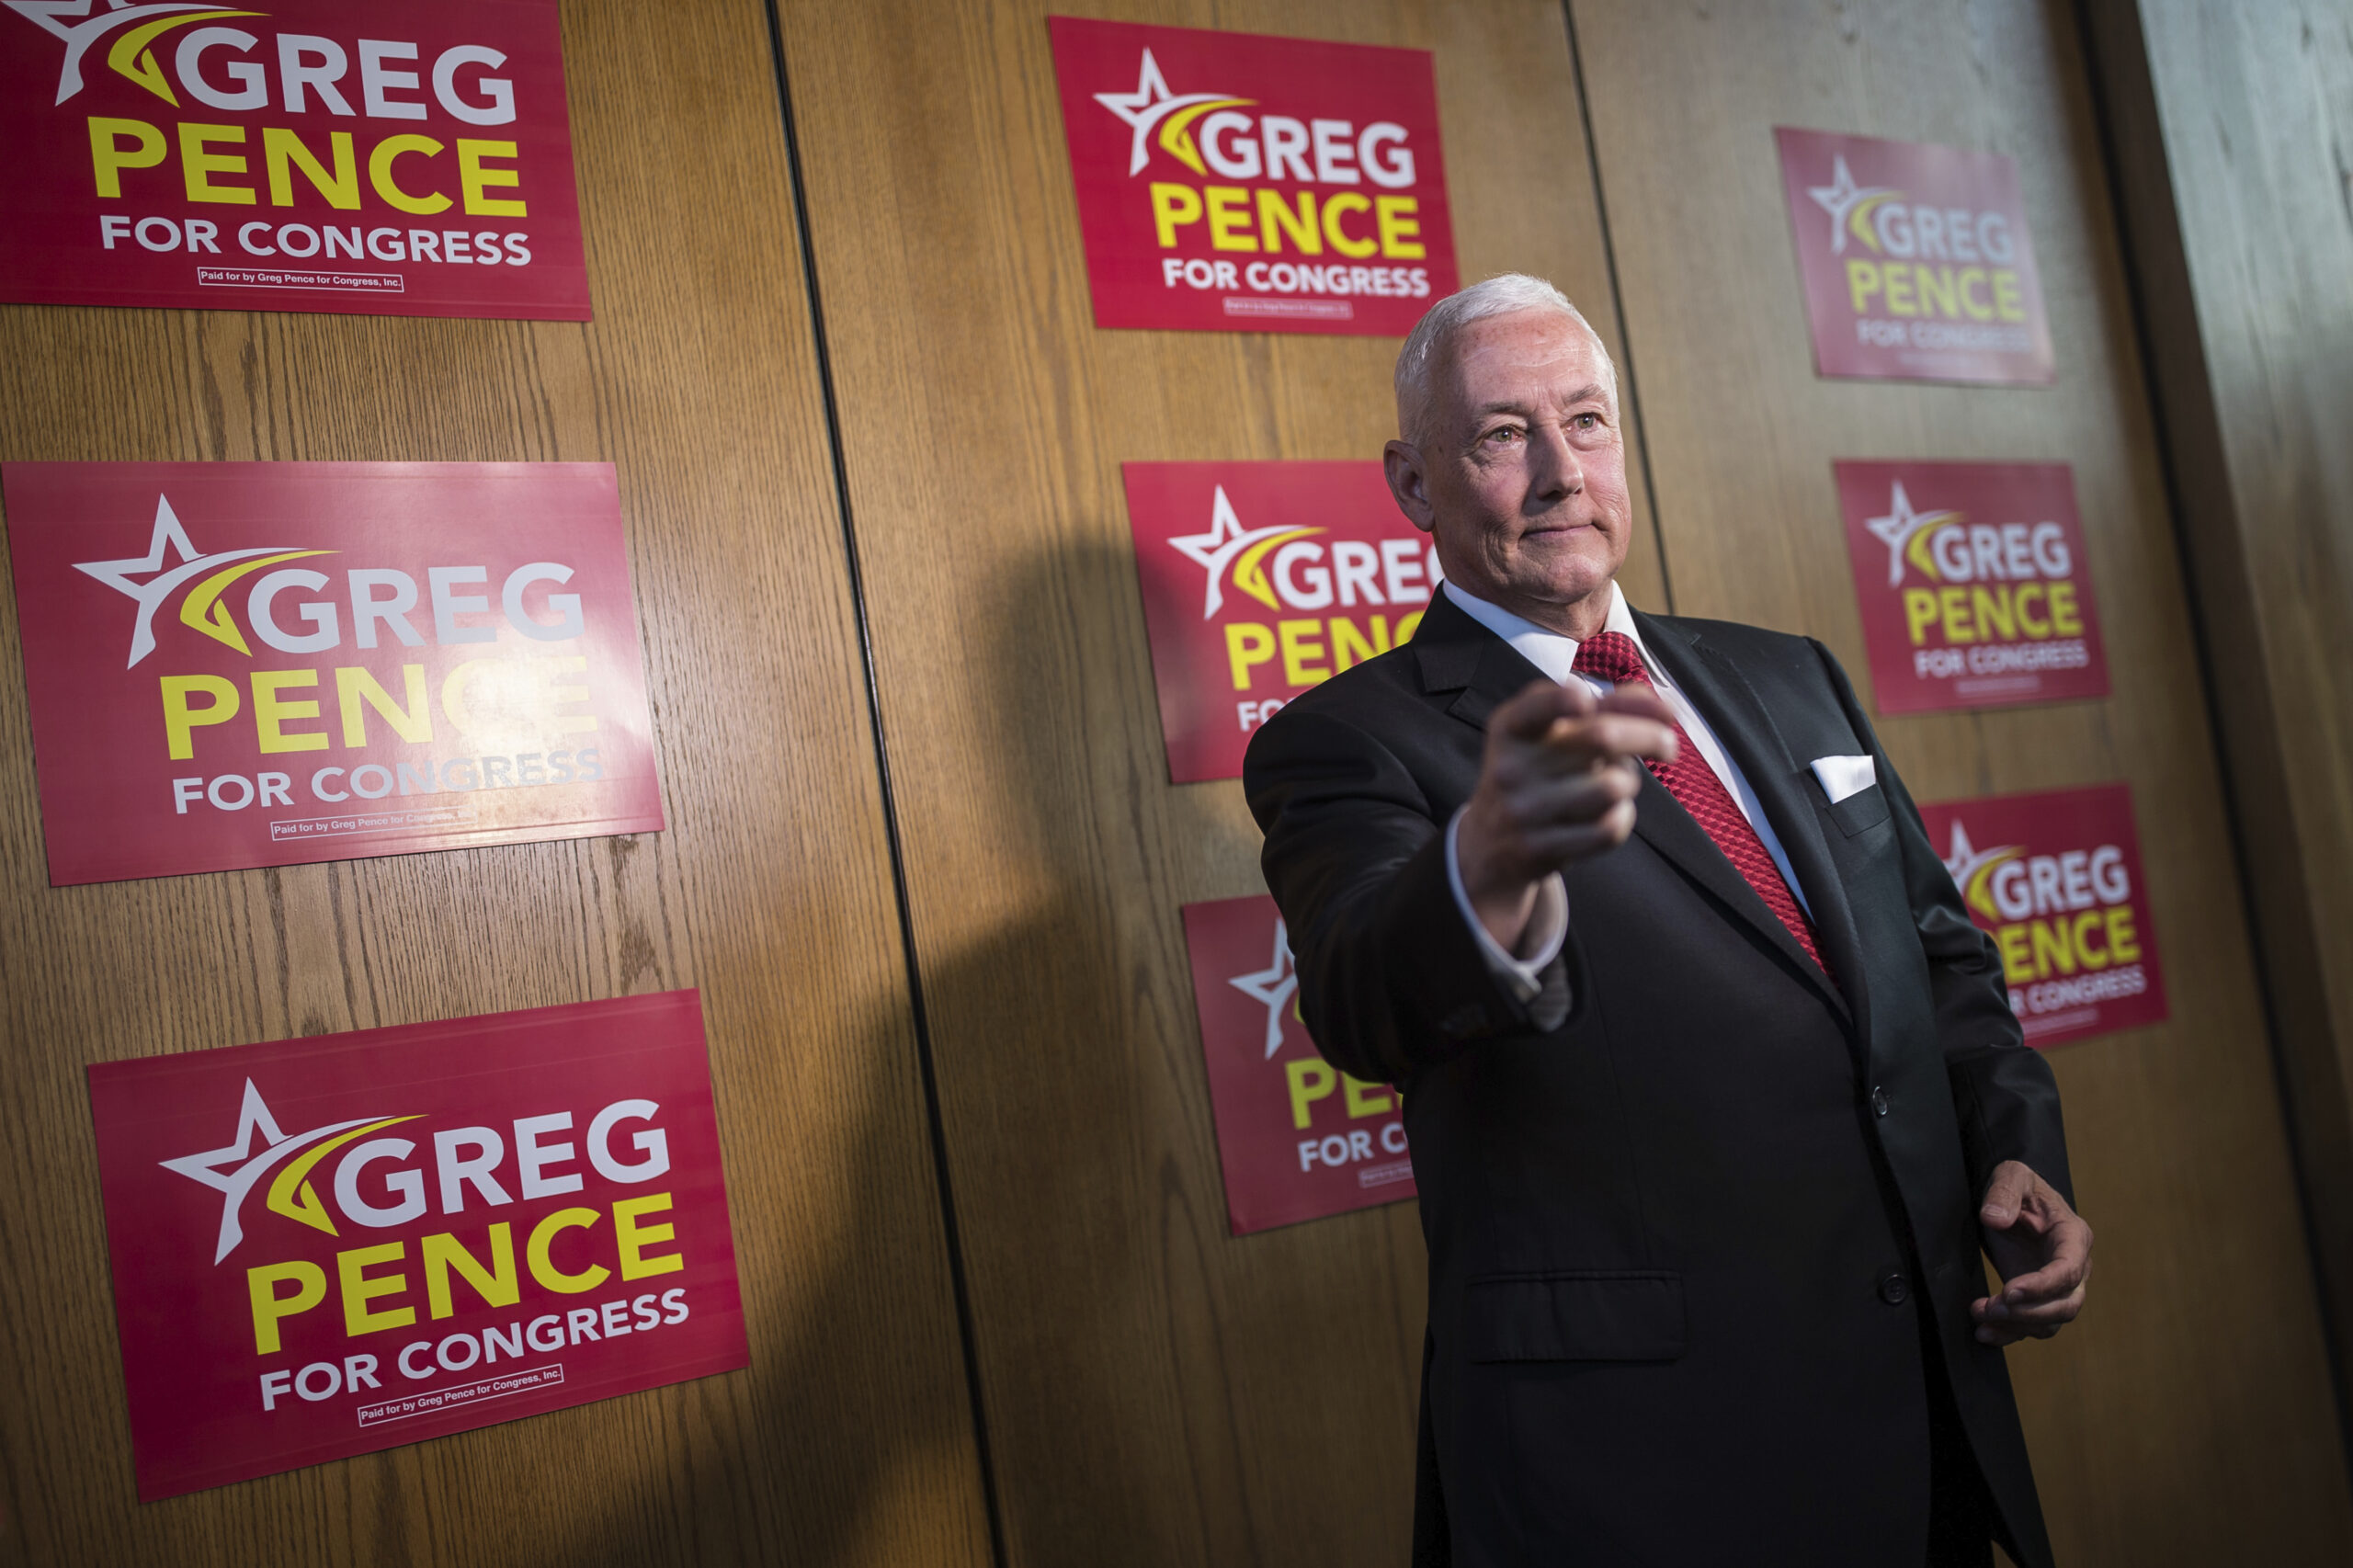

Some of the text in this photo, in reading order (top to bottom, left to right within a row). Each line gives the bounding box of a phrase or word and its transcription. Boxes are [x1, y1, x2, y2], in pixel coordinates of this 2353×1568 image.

[175, 26, 517, 127] GREG
[86, 116, 529, 218] PENCE
[1199, 110, 1417, 188] GREG
[99, 214, 532, 267] FOR CONGRESS
[1149, 181, 1427, 260] PENCE
[1874, 201, 2016, 265] GREG
[200, 271, 402, 287] Paid for by Greg Pence for Congress, Inc.
[1161, 257, 1432, 299] FOR CONGRESS
[1844, 256, 2028, 322] PENCE
[1932, 521, 2073, 584] GREG
[247, 562, 585, 653] GREG
[1903, 580, 2085, 646] PENCE
[1913, 647, 1967, 679] FOR
[1236, 697, 1294, 732] FO
[172, 747, 605, 814] FOR CONGRESS
[274, 824, 297, 835] Paid
[299, 824, 313, 833] for
[315, 823, 328, 833] by
[330, 820, 356, 831] Greg
[358, 817, 388, 827] Pence
[390, 815, 404, 825] for
[1991, 844, 2131, 920] GREG
[1985, 904, 2143, 985] ENCE
[333, 1097, 672, 1229] GREG
[1297, 1129, 1374, 1173] FOR
[246, 1191, 685, 1357] PENCE
[259, 1287, 691, 1413] FOR CONGRESS
[360, 1369, 562, 1421] Paid for by Greg Pence for Congress, Inc.
